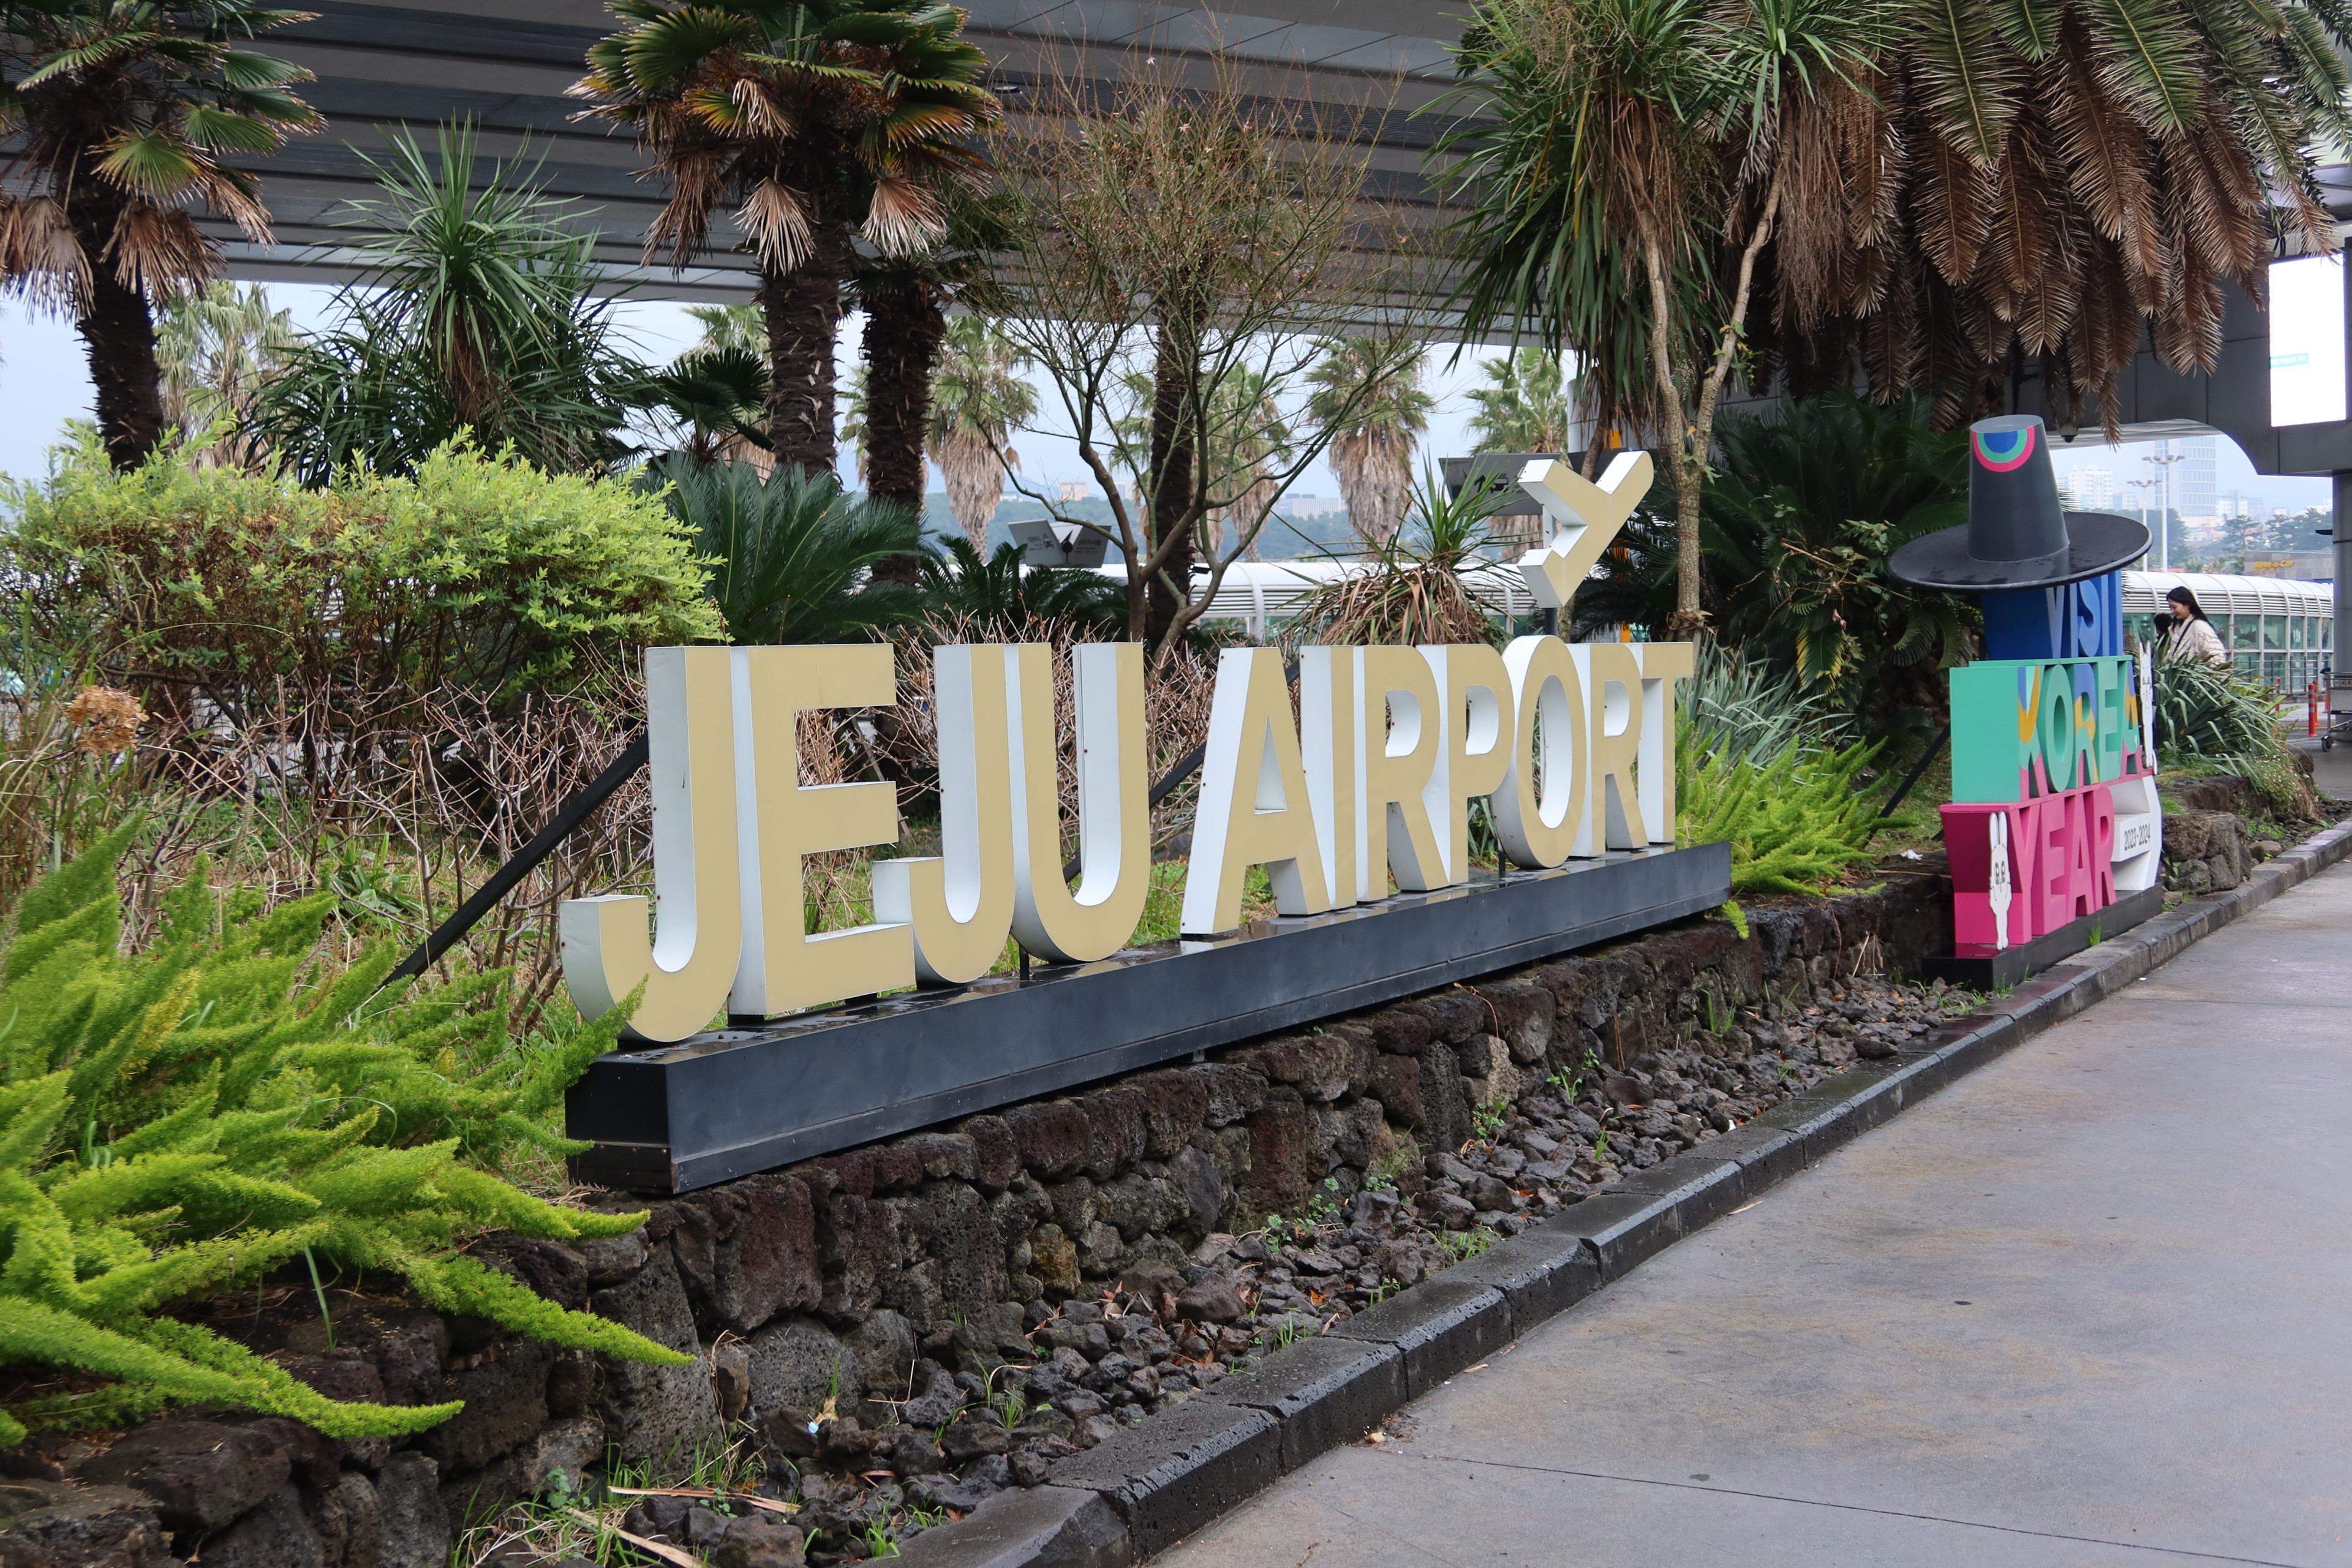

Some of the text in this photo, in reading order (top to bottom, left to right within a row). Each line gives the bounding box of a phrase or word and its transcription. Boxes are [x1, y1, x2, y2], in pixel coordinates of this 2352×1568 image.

[2018, 661, 2143, 803] KOREA
[562, 635, 1694, 1043] JEJU AIRPORT
[2009, 786, 2117, 944] YEAR
[2124, 823, 2150, 851] 2023-2024
